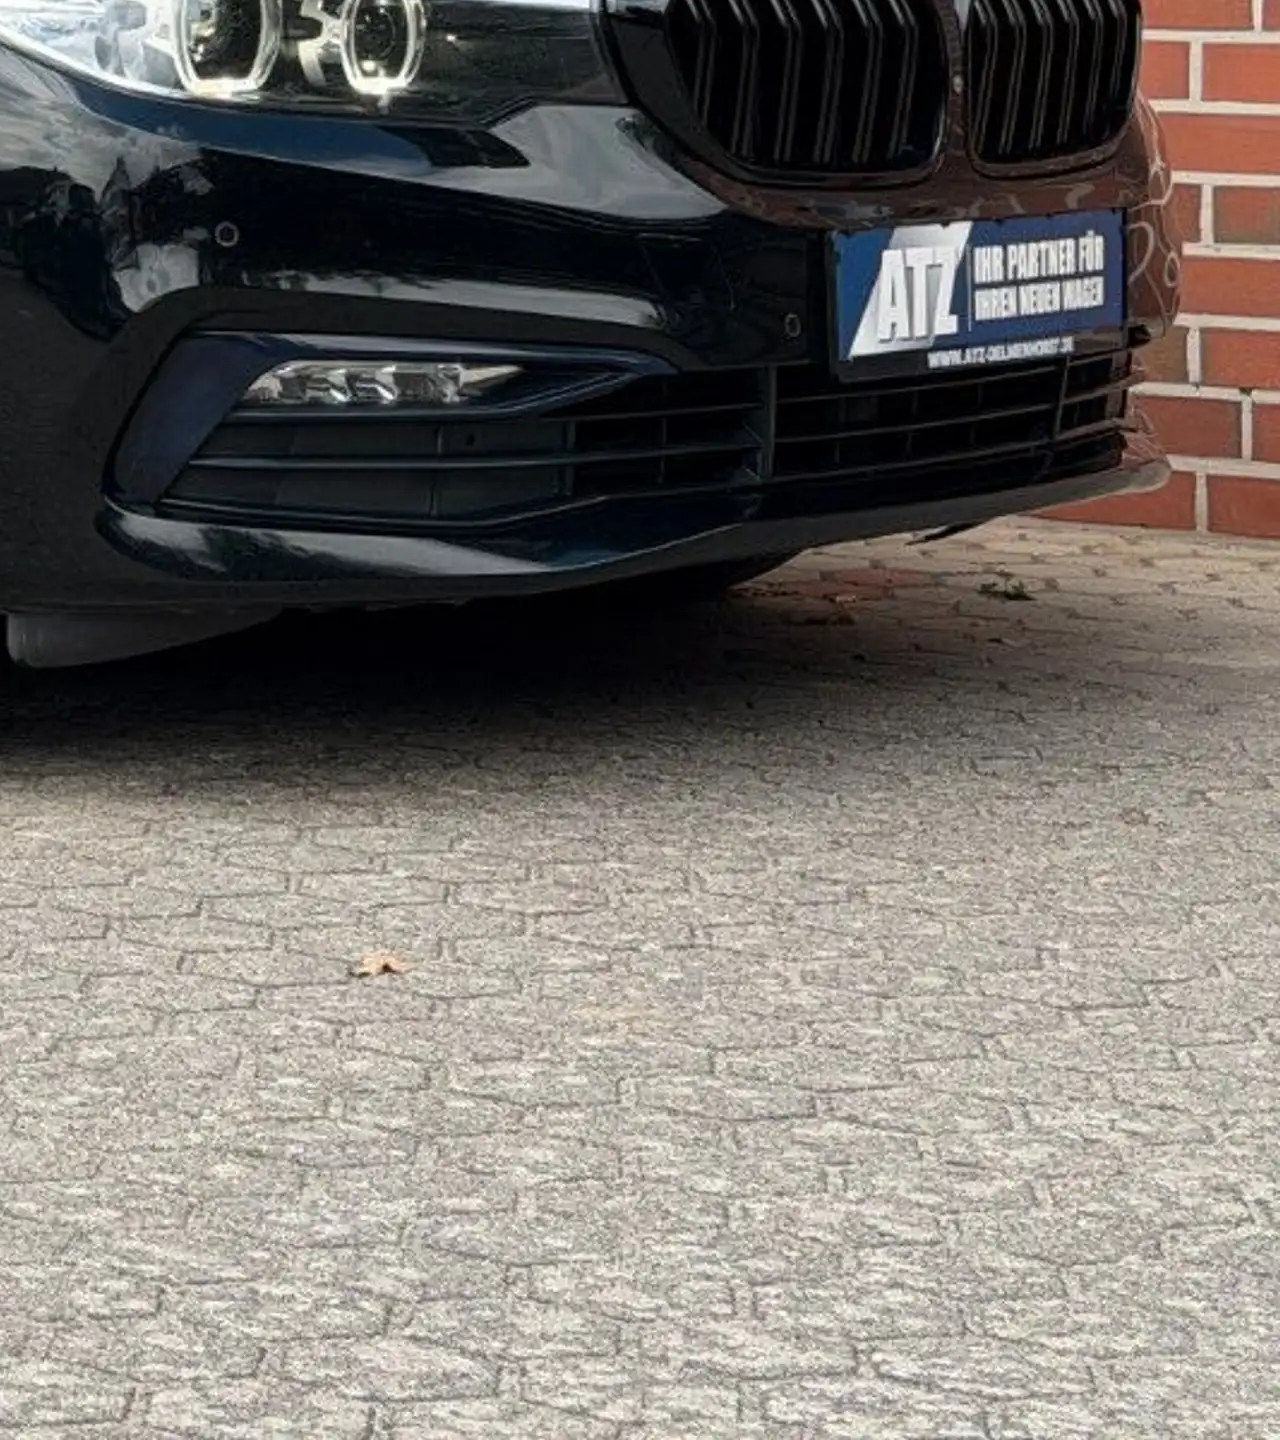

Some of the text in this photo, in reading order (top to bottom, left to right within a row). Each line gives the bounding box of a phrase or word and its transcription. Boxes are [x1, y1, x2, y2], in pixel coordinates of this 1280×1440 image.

[973, 229, 1104, 284] IHR PARTNER FÜR
[877, 246, 959, 343] ATZ
[1018, 280, 1061, 316] NEUEN
